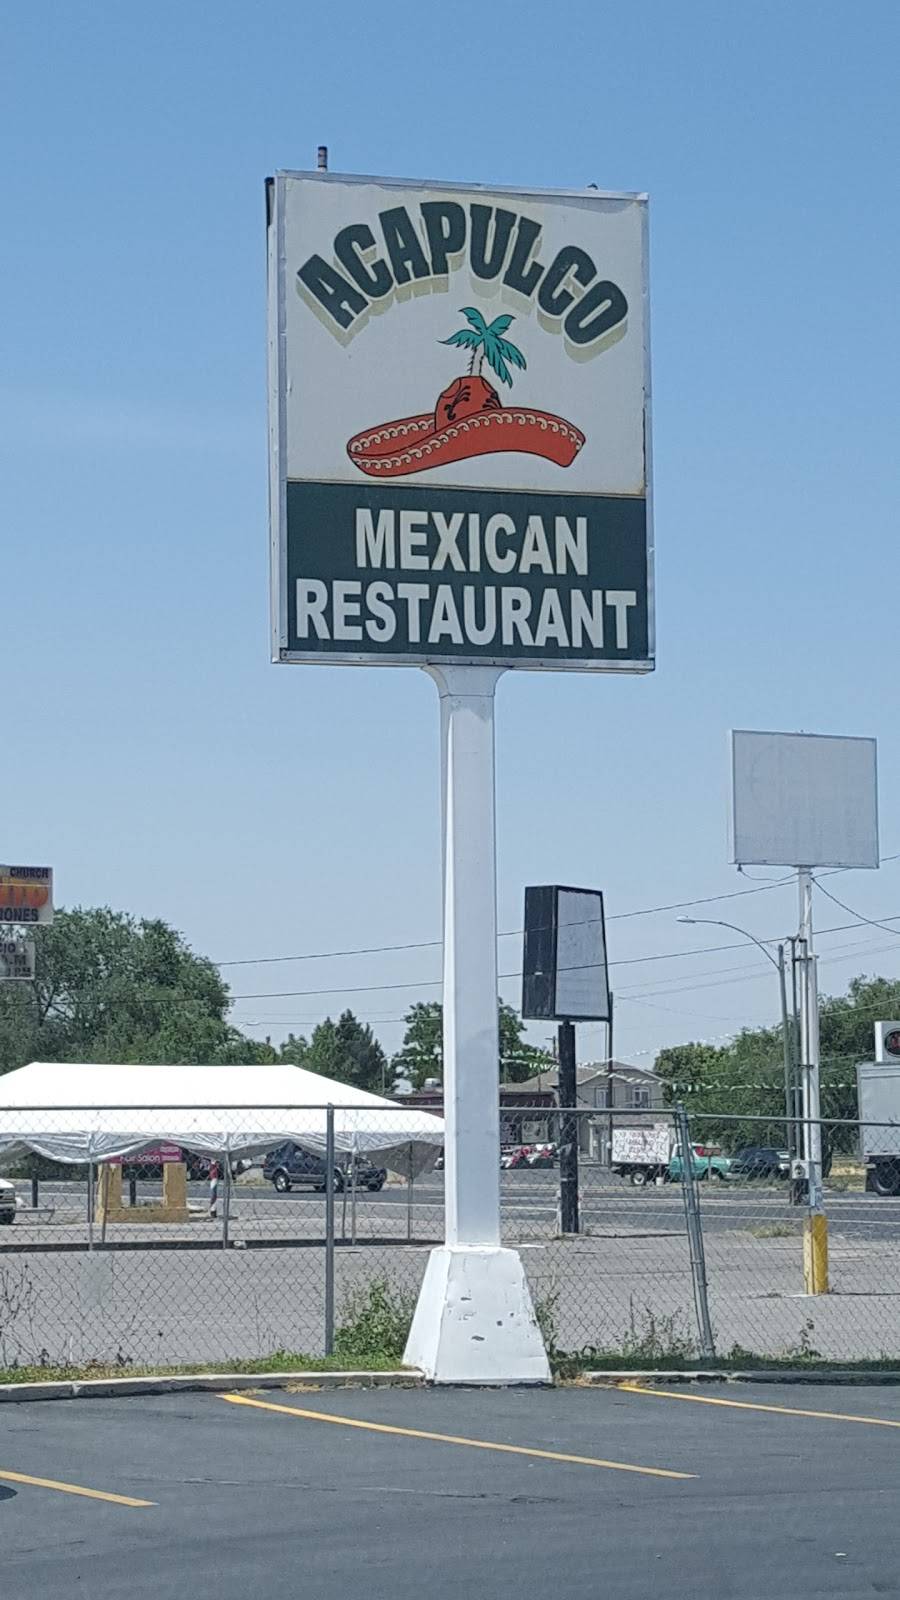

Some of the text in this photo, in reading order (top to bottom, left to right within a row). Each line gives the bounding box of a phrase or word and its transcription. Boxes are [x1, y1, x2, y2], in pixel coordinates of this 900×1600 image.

[296, 201, 628, 346] ACAPULCO
[355, 508, 588, 576] MEXICAN
[295, 578, 637, 649] RESTAURANT
[10, 867, 49, 879] CHURCH
[138, 1154, 161, 1162] Salon
